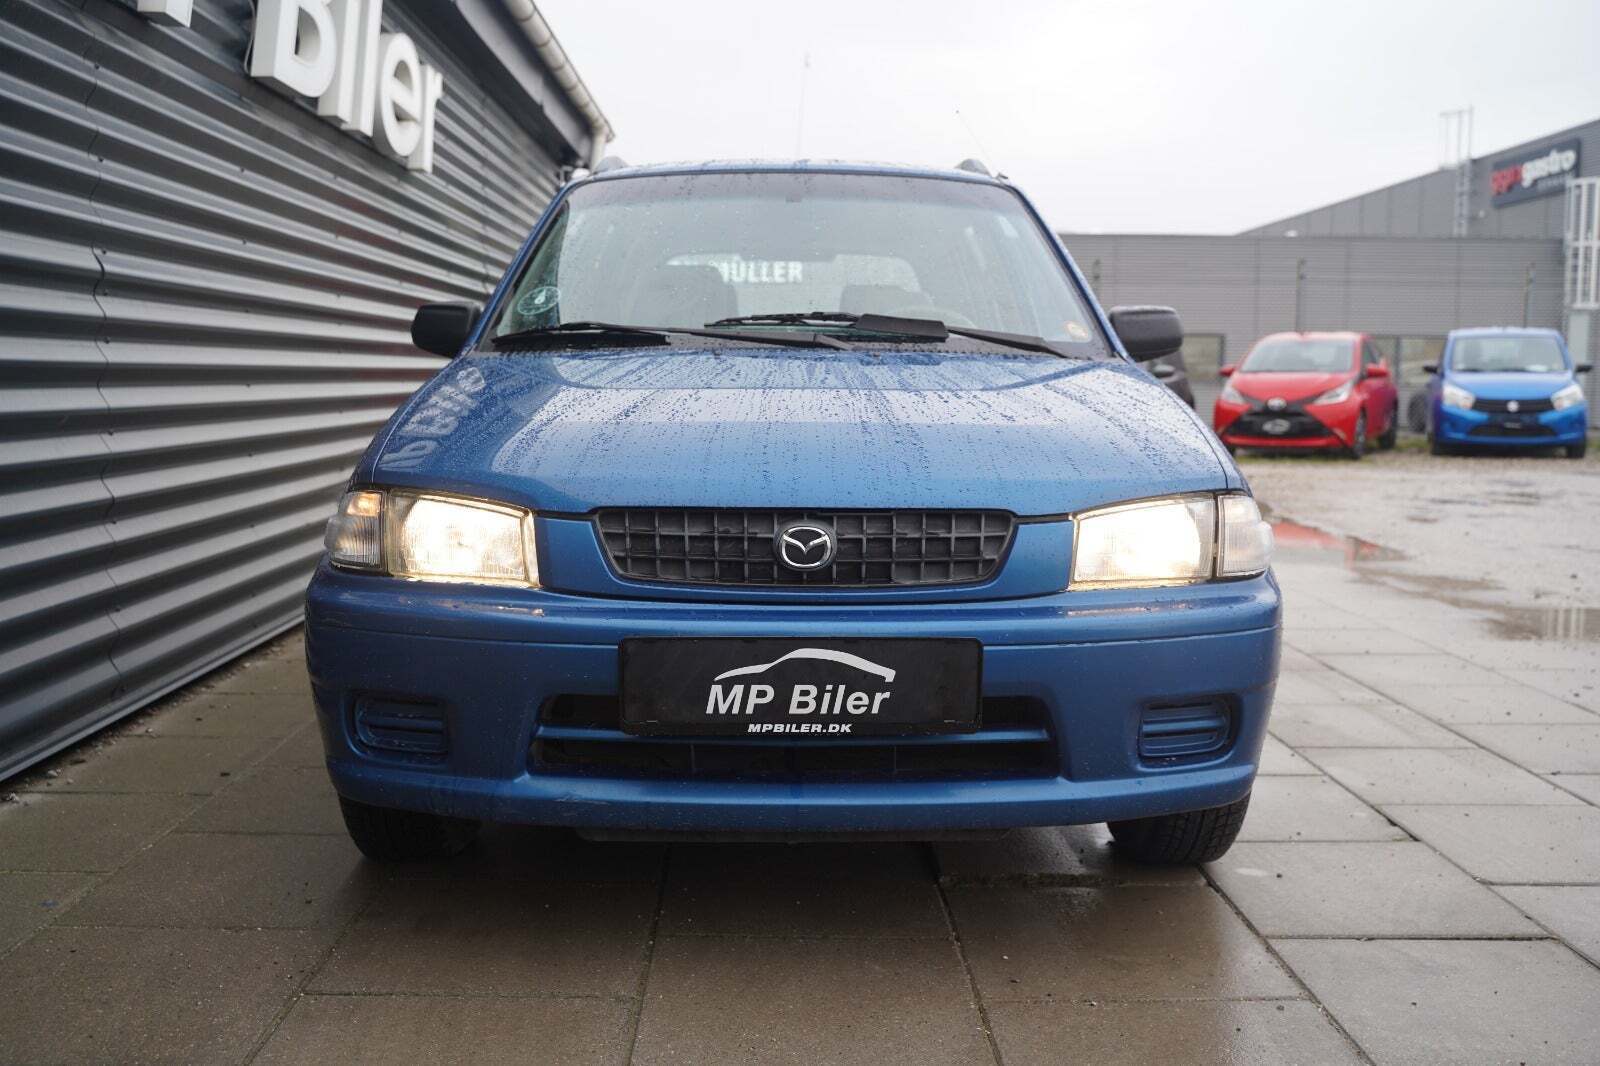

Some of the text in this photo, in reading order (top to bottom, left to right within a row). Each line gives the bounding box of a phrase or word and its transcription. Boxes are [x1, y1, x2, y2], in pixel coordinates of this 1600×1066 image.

[705, 684, 891, 715] MP Biler
[747, 723, 853, 733] MPBILER.DK
